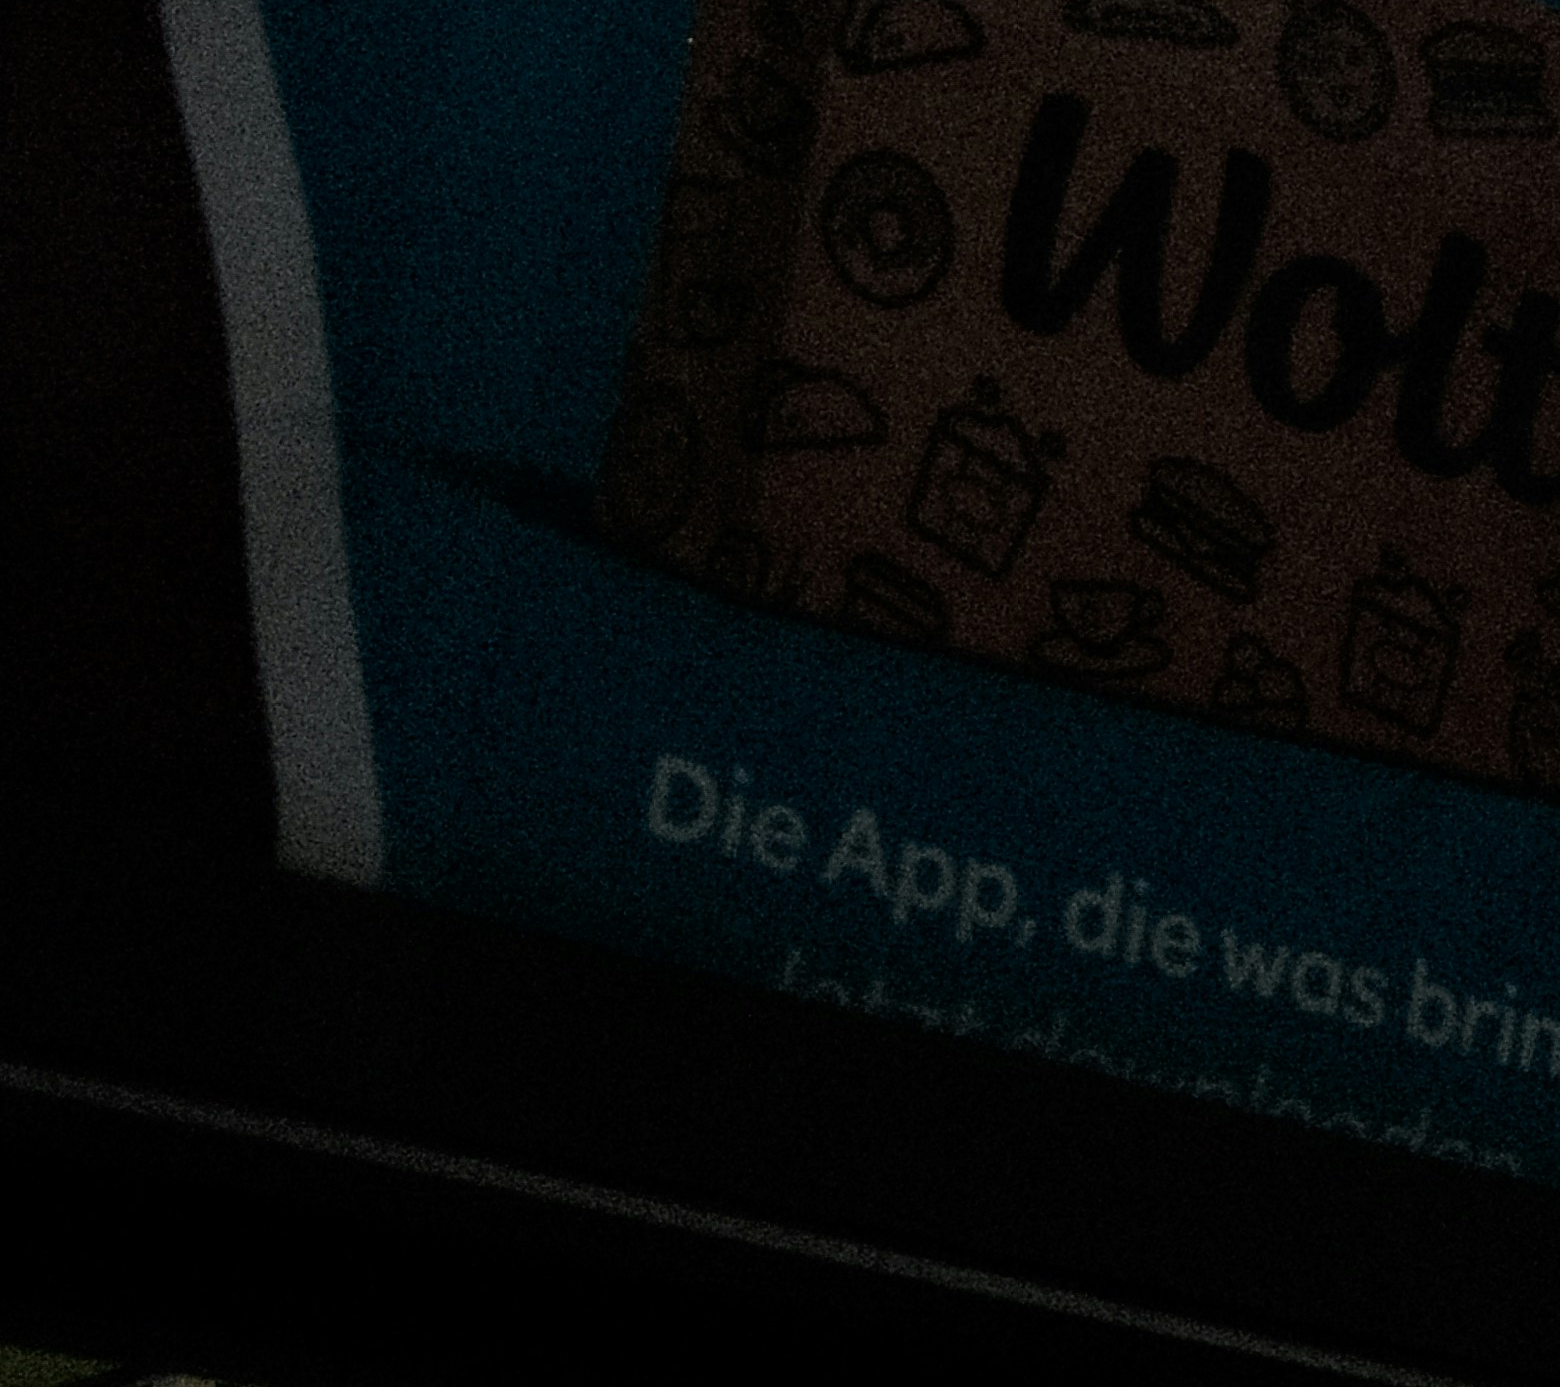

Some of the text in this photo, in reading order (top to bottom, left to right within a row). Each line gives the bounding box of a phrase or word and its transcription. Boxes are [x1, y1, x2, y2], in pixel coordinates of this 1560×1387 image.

[645, 752, 809, 875] Die
[819, 804, 1038, 949] App,
[1061, 869, 1202, 981] die
[1219, 924, 1391, 1029] was
